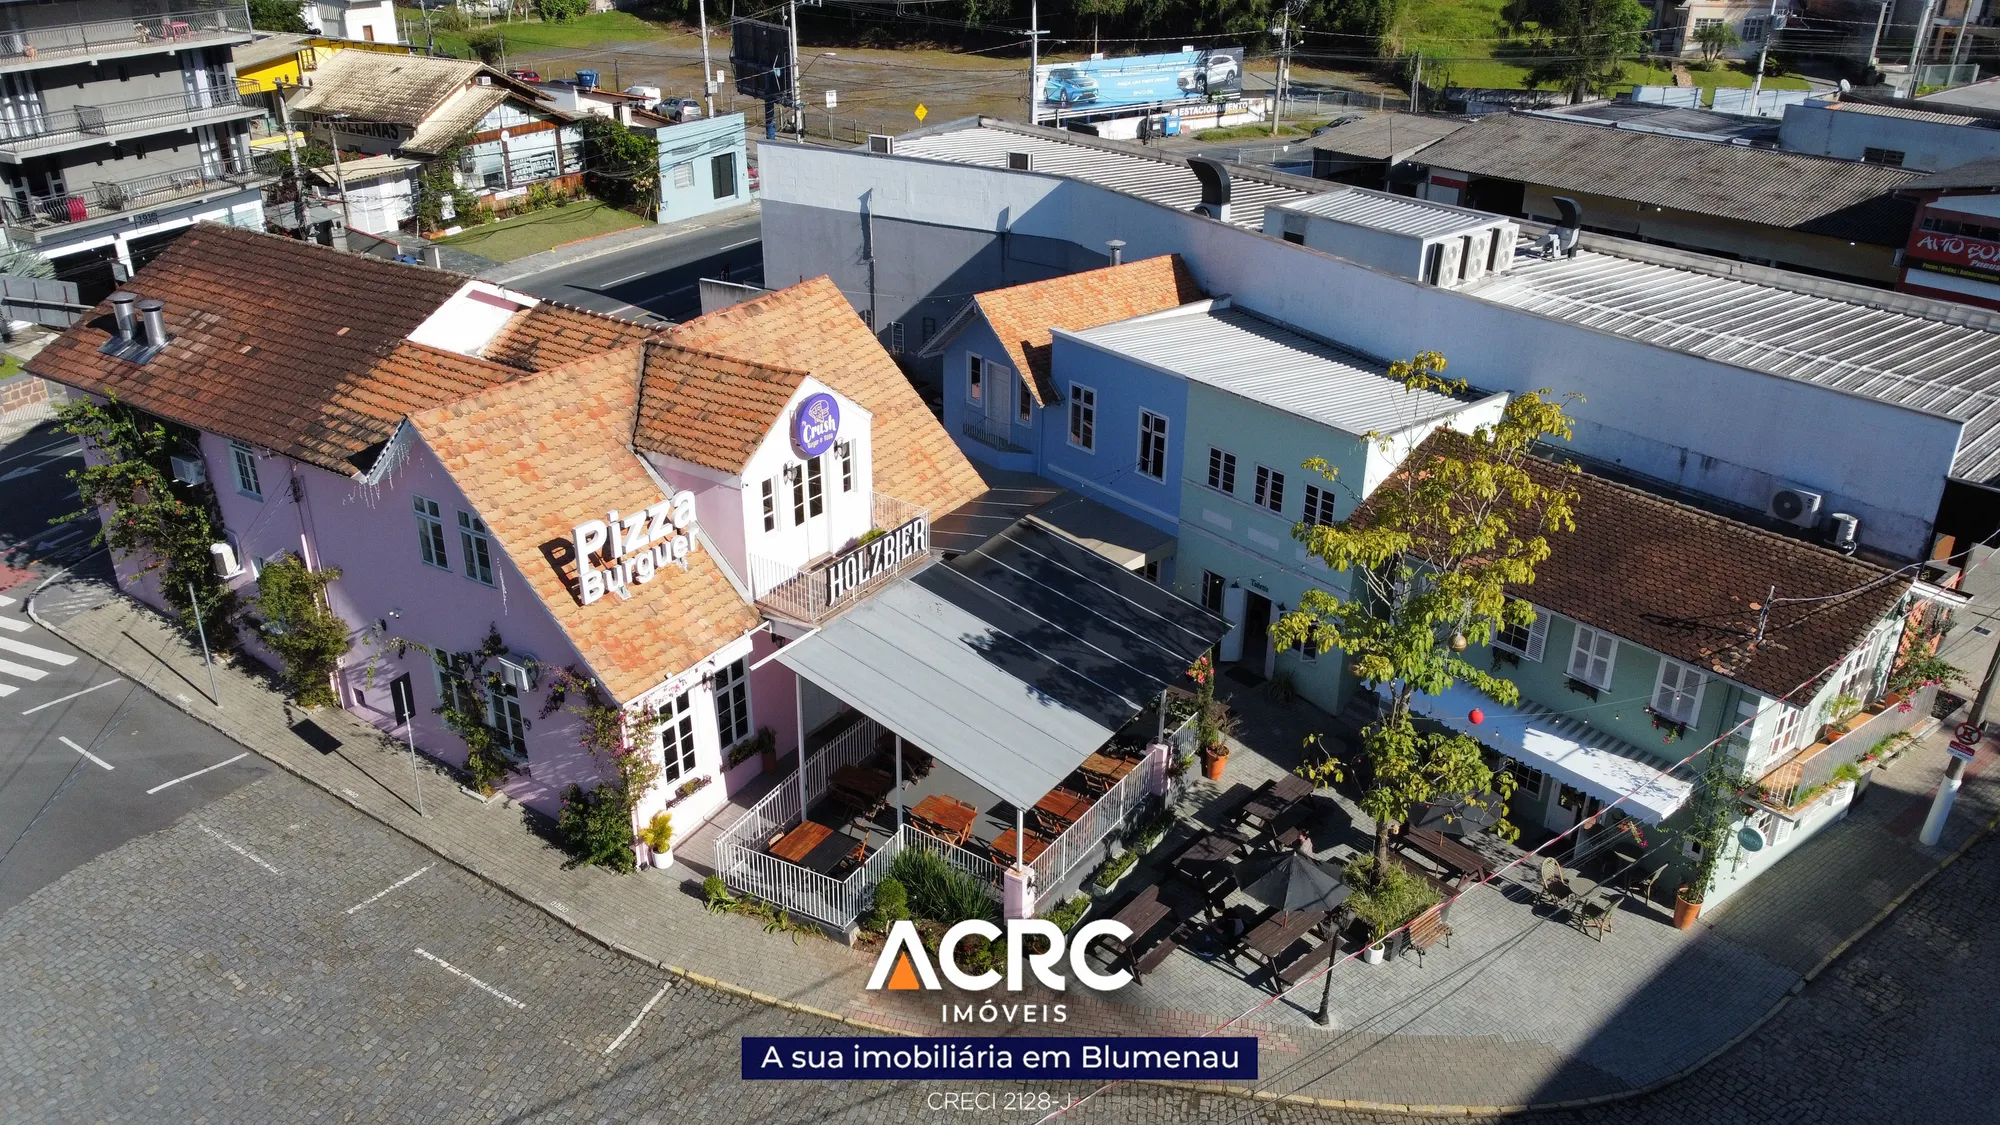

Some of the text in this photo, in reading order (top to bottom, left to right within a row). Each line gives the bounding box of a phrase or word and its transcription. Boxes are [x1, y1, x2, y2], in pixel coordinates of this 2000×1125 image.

[1917, 235, 1964, 254] AUTO
[803, 414, 836, 443] Crush
[572, 490, 697, 575] Pizza
[581, 525, 700, 605] Burguer
[829, 518, 927, 606] HOLZBIER
